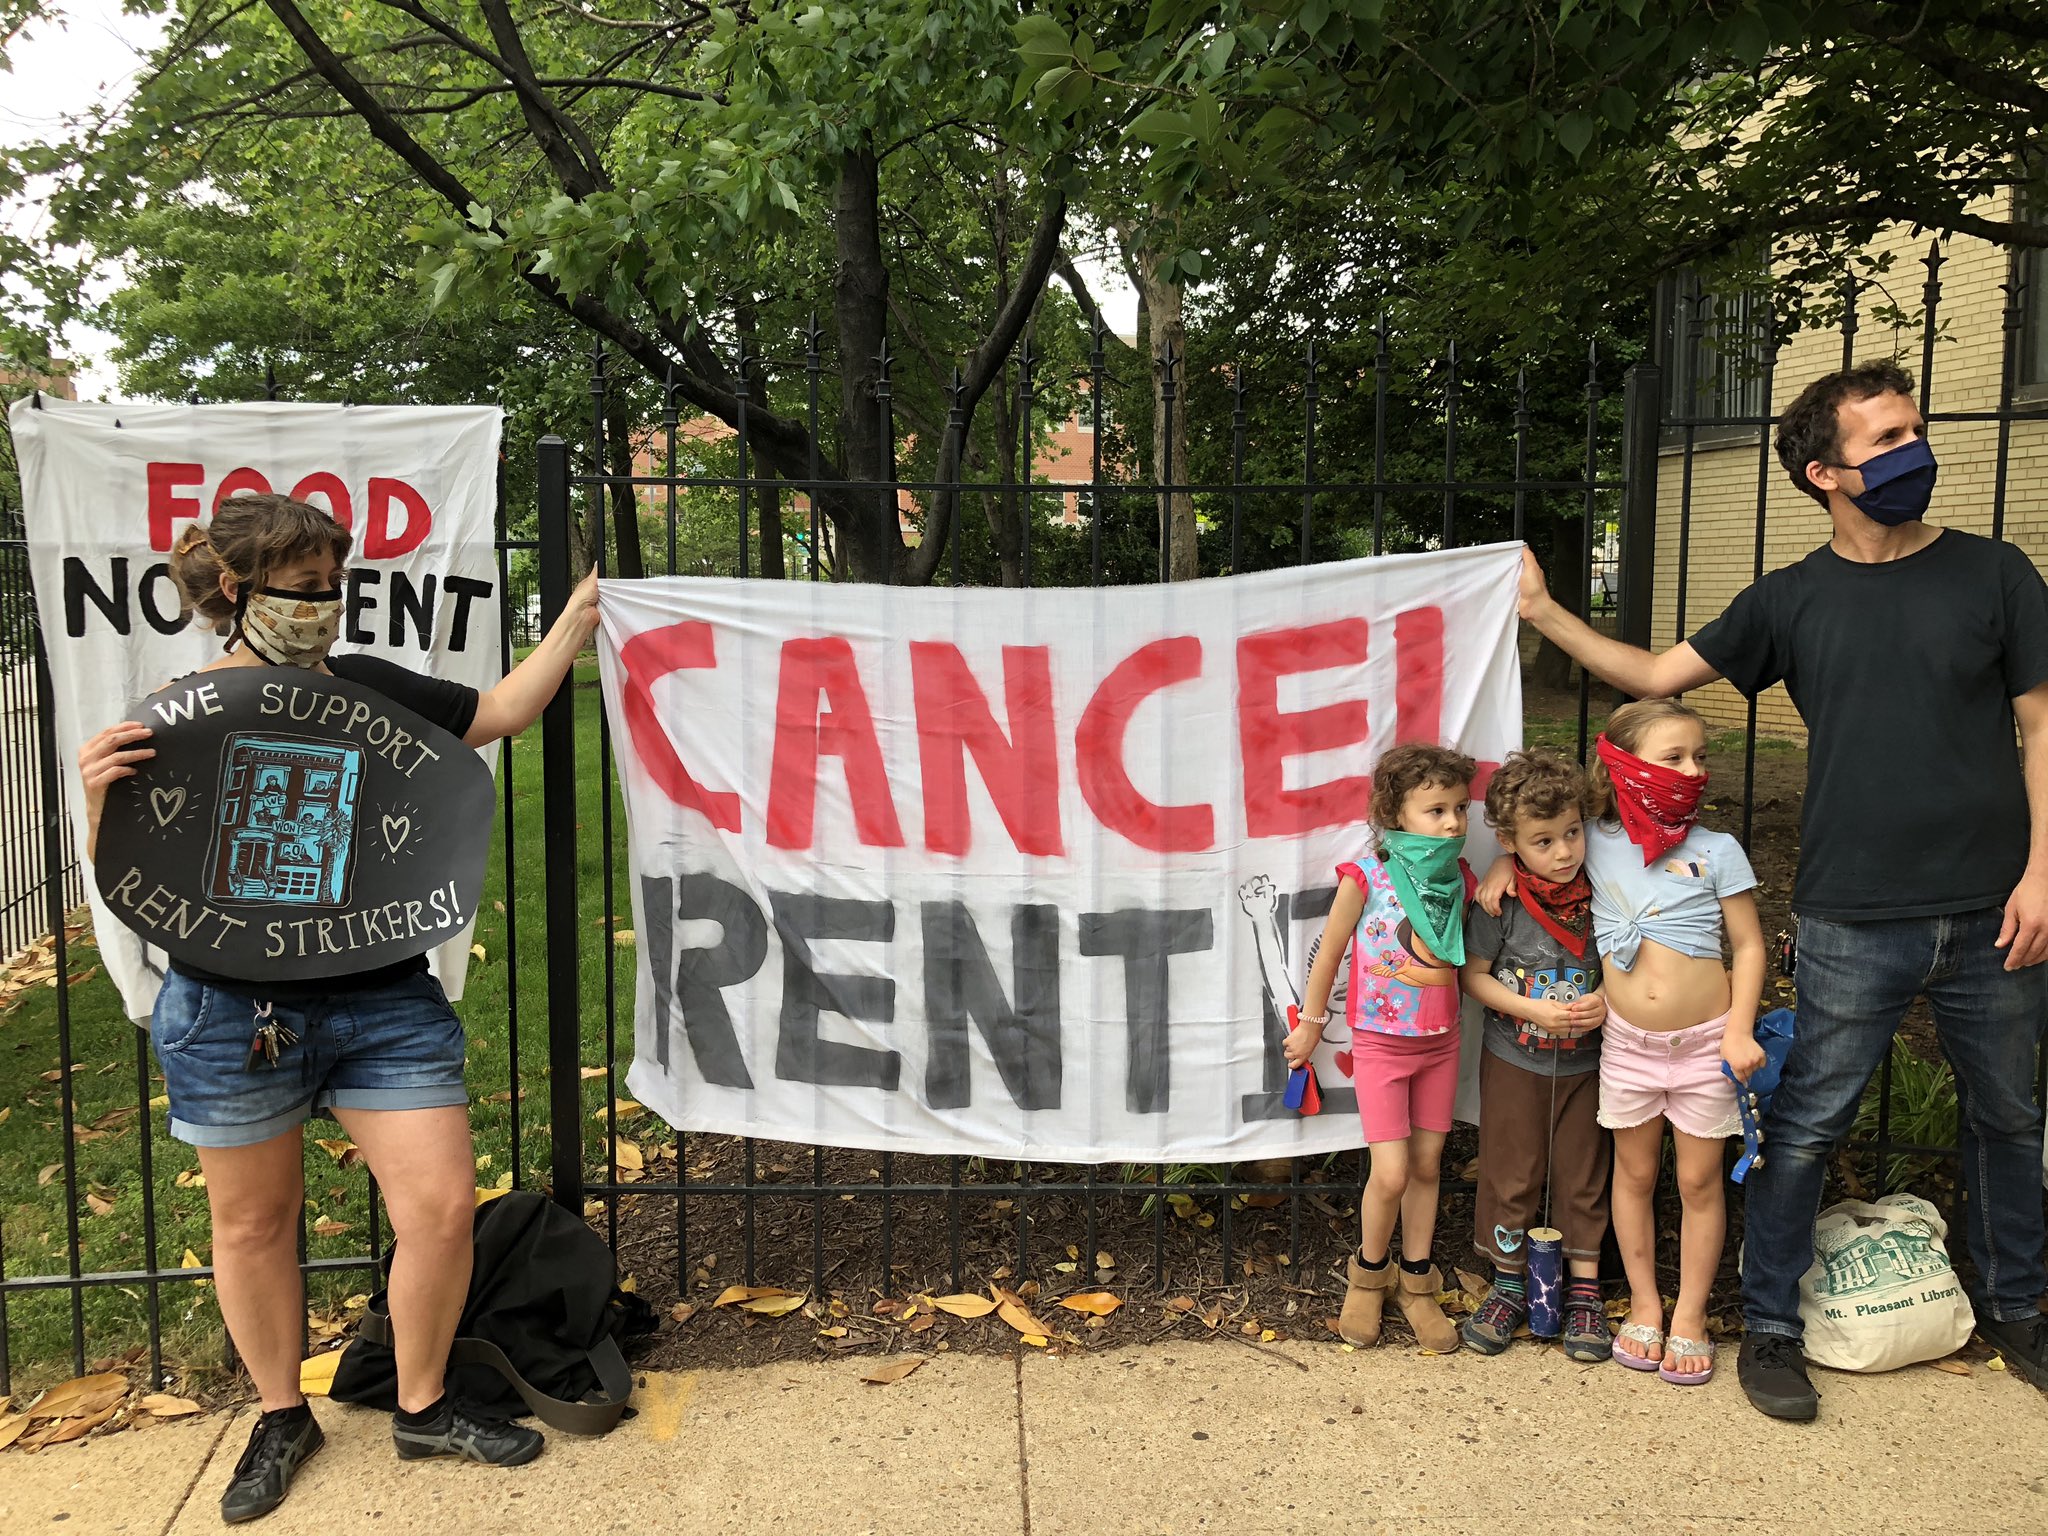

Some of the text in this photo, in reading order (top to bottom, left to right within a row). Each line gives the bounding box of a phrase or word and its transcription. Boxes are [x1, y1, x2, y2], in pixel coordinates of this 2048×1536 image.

[63, 556, 193, 637] NO
[152, 682, 440, 779] WE SUPPORT
[619, 605, 1500, 857] CANCEL
[106, 866, 465, 958] RENT STRIKERS!
[641, 872, 1213, 1115] RENT
[1825, 1286, 1960, 1321] Mt. Pleasant Library
